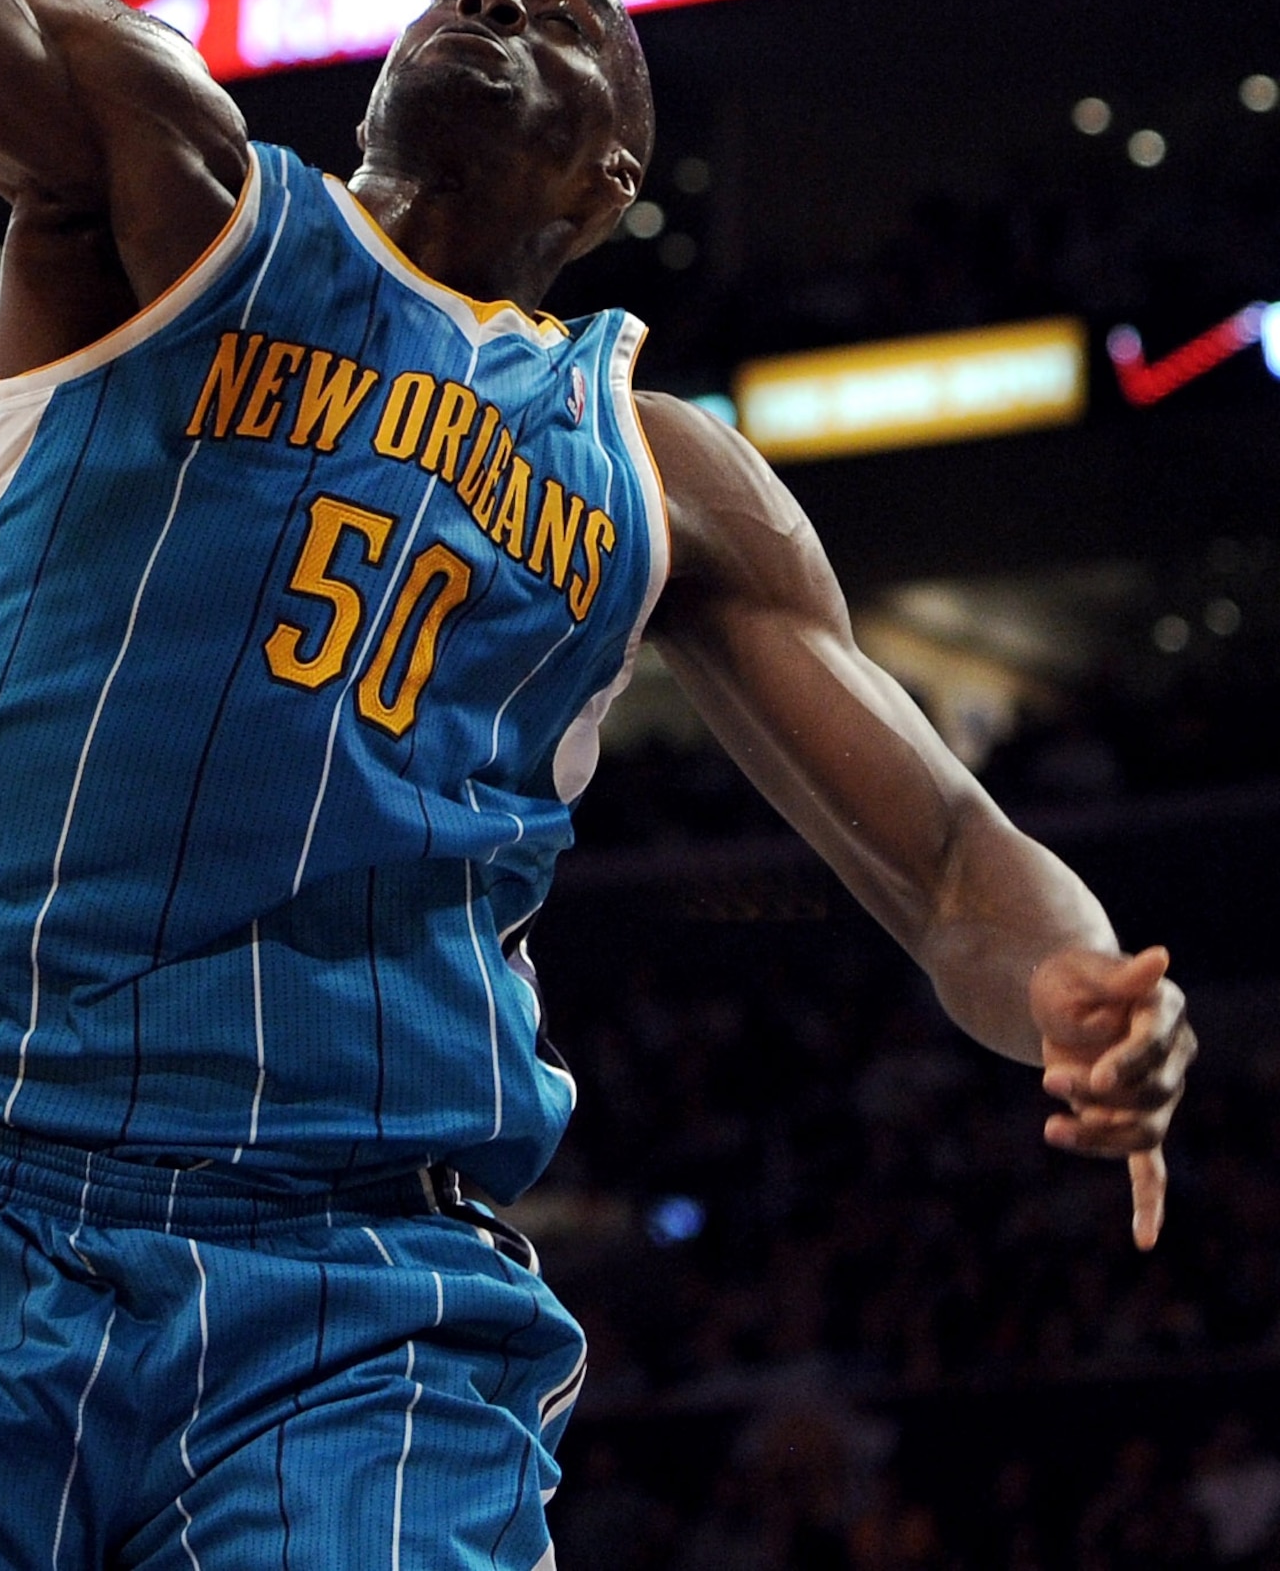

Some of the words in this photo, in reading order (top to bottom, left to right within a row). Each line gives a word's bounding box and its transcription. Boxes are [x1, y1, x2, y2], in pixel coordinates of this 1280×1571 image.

[186, 332, 380, 455] NEW
[370, 370, 617, 626] ORLEANS
[261, 492, 473, 741] 50
